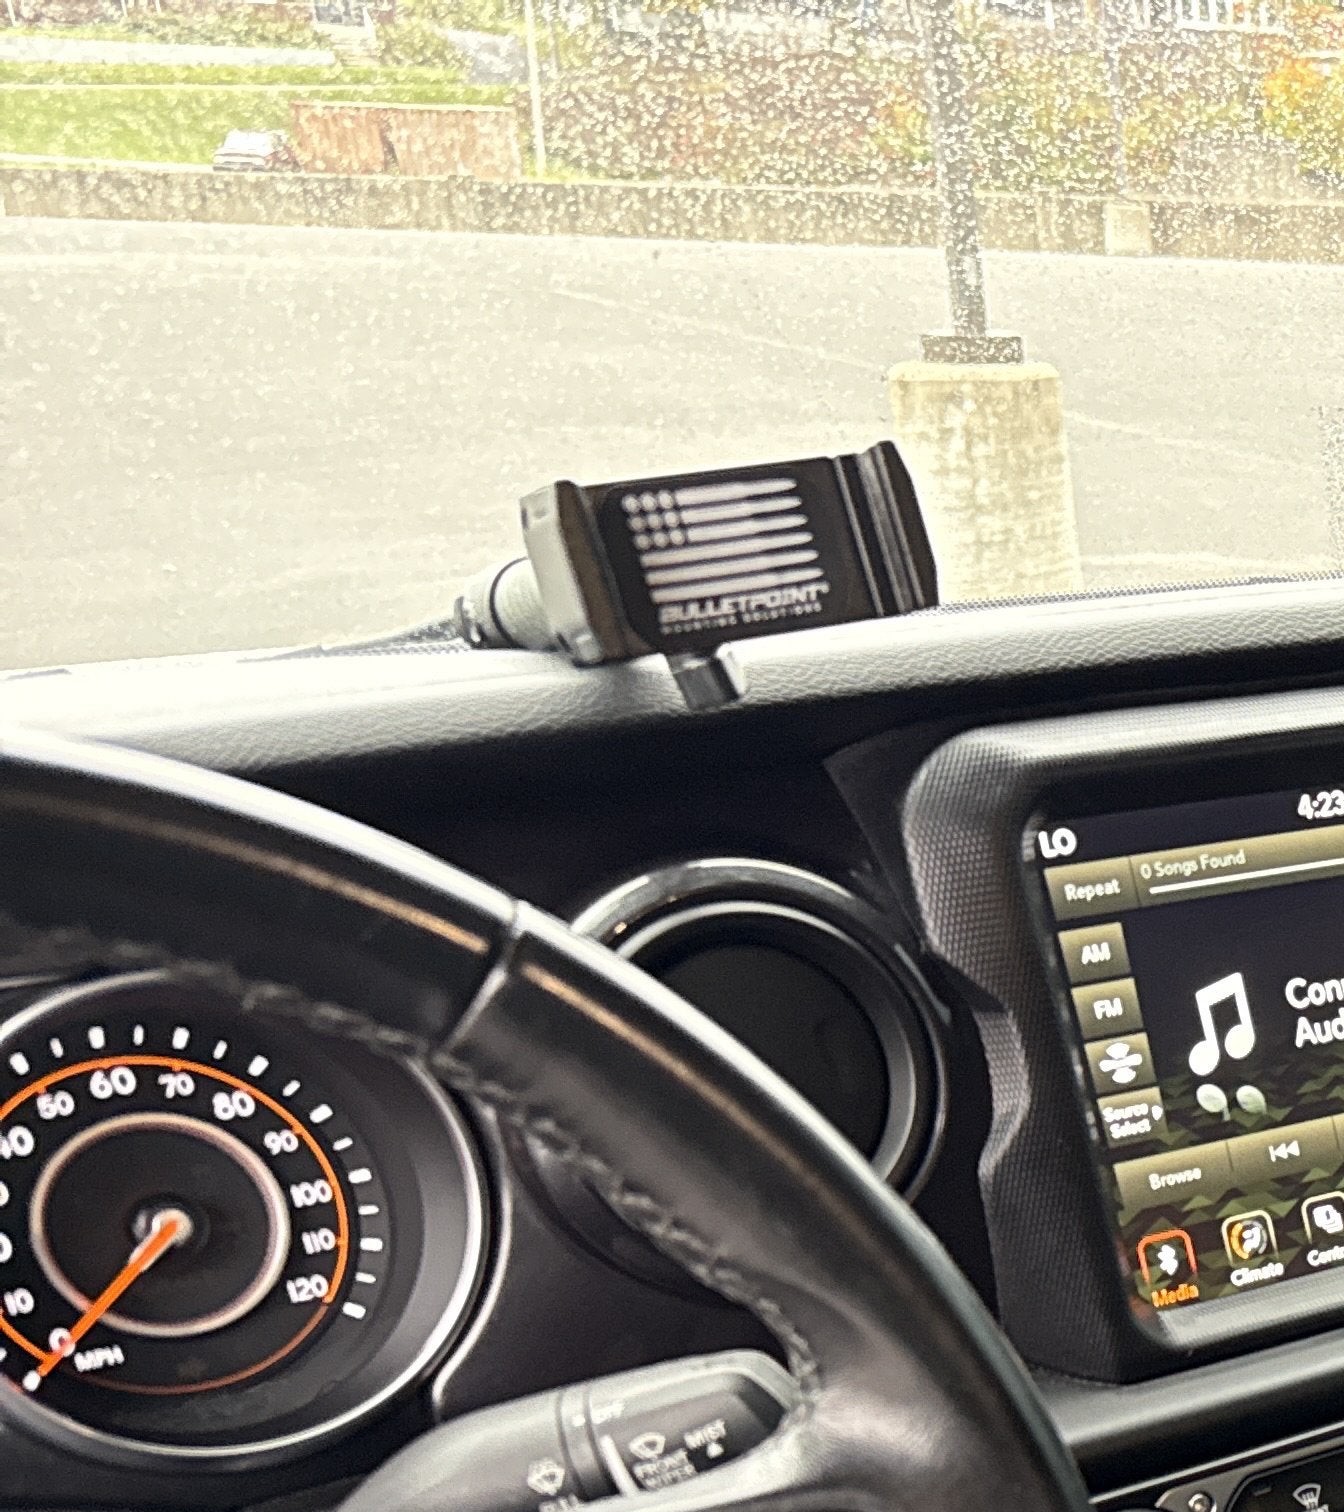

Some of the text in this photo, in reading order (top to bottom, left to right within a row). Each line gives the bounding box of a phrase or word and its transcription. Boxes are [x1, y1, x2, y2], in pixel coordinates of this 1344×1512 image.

[1038, 827, 1077, 859] LO
[1140, 849, 1246, 880] 0 Songs Found
[1064, 878, 1121, 903] Repeat
[1081, 941, 1111, 965] AM
[1093, 997, 1123, 1020] FM
[89, 1064, 137, 1102] 60
[157, 1071, 196, 1100] 70
[36, 1090, 75, 1121] 50
[212, 1089, 257, 1122] 80
[1103, 1102, 1149, 1123] Source
[1109, 1116, 1151, 1139] Select
[263, 1129, 300, 1156] 90
[1149, 1167, 1202, 1191] Browse
[290, 1180, 334, 1208] 100
[301, 1226, 337, 1254] 110
[286, 1273, 330, 1304] 120
[1230, 1261, 1285, 1288] Climate
[4, 1287, 35, 1317] 10
[1151, 1282, 1200, 1309] Media
[74, 1343, 125, 1373] MPH
[633, 1448, 688, 1480] FRONT
